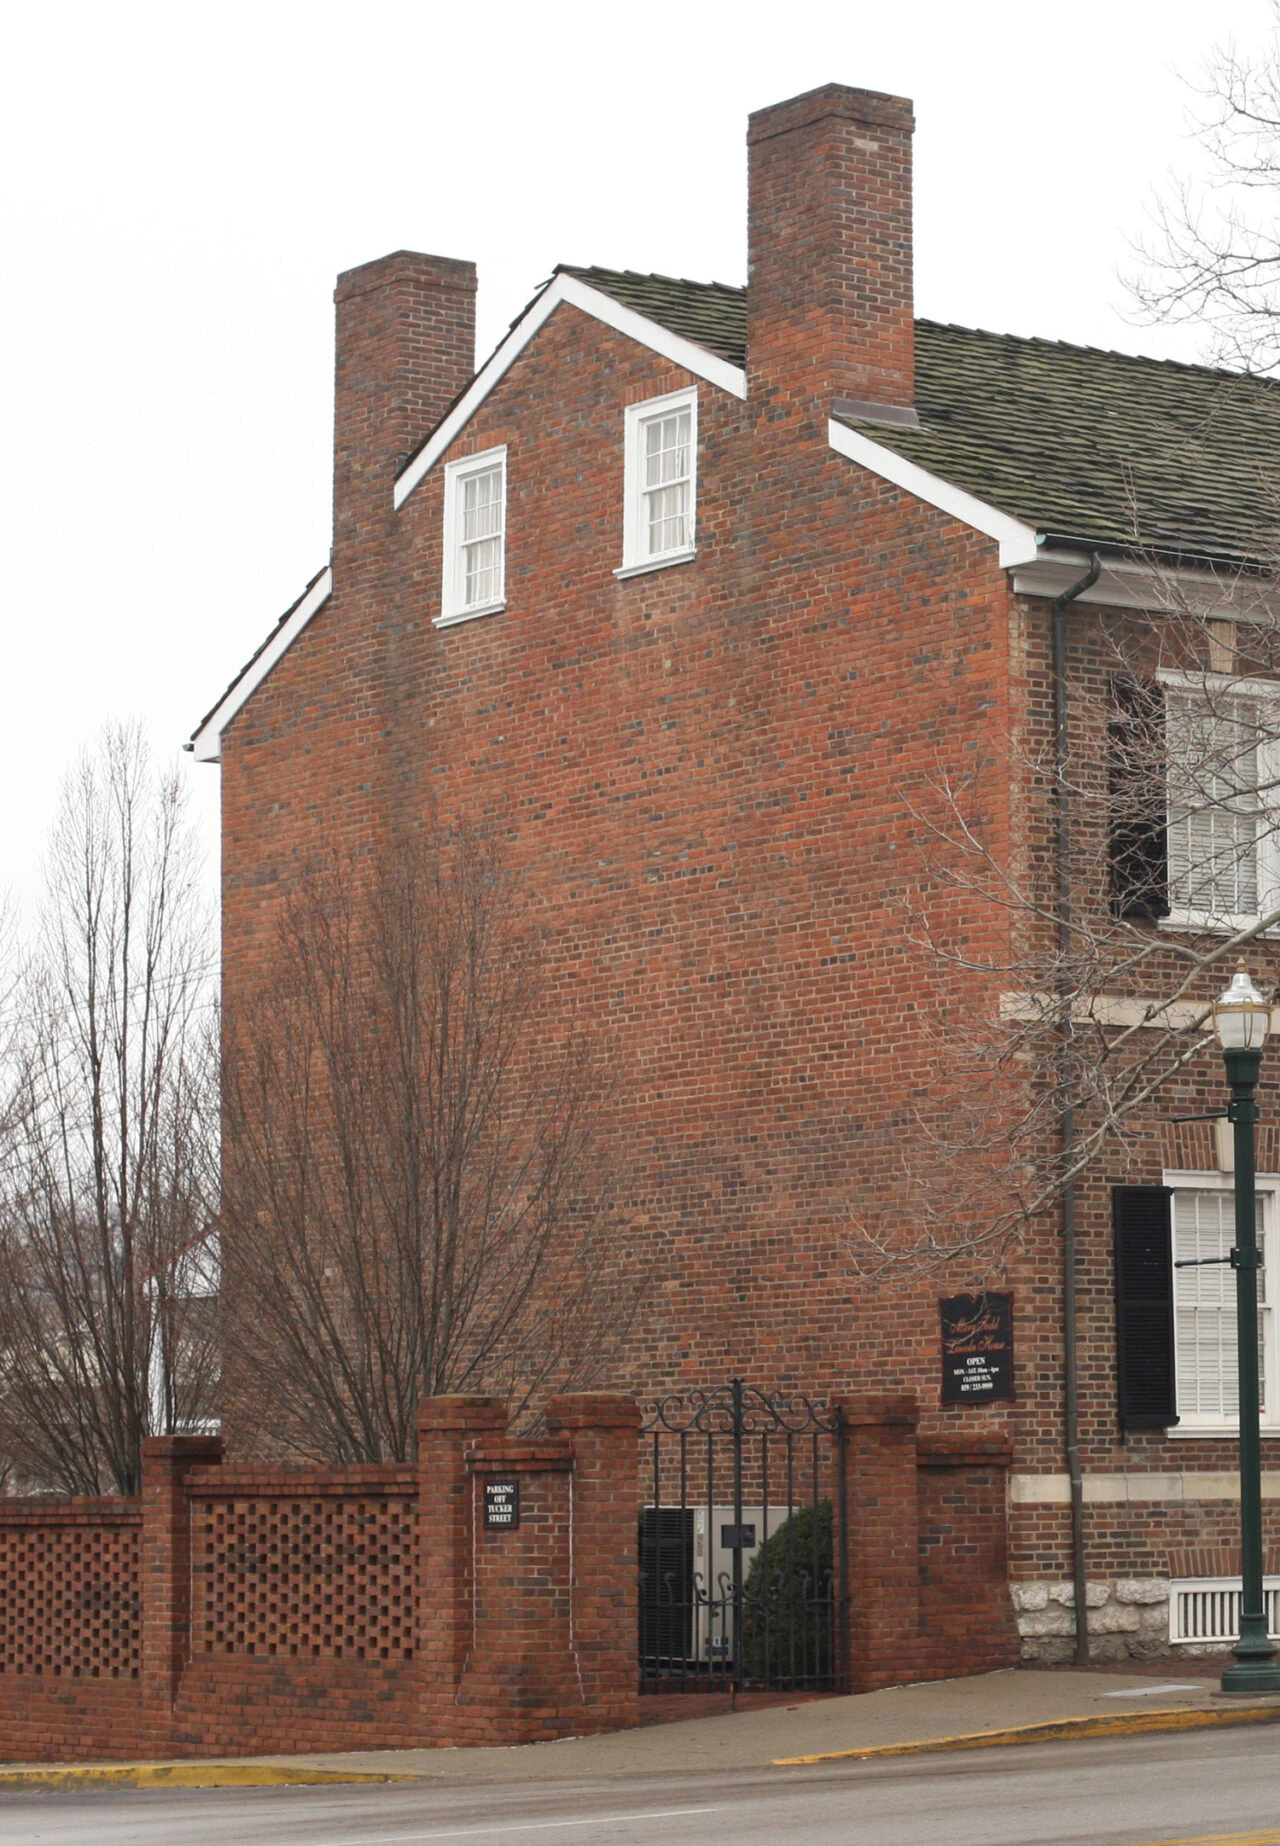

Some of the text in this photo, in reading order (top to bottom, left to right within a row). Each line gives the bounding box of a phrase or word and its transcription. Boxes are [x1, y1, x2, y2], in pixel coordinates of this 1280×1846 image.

[978, 1335, 1006, 1351] House
[966, 1356, 986, 1366] OPEN
[963, 1375, 981, 1383] CLOSED
[486, 1484, 514, 1494] PARKING
[493, 1495, 506, 1504] OFF
[488, 1504, 513, 1513] TUCKER
[488, 1513, 512, 1523] STREET
